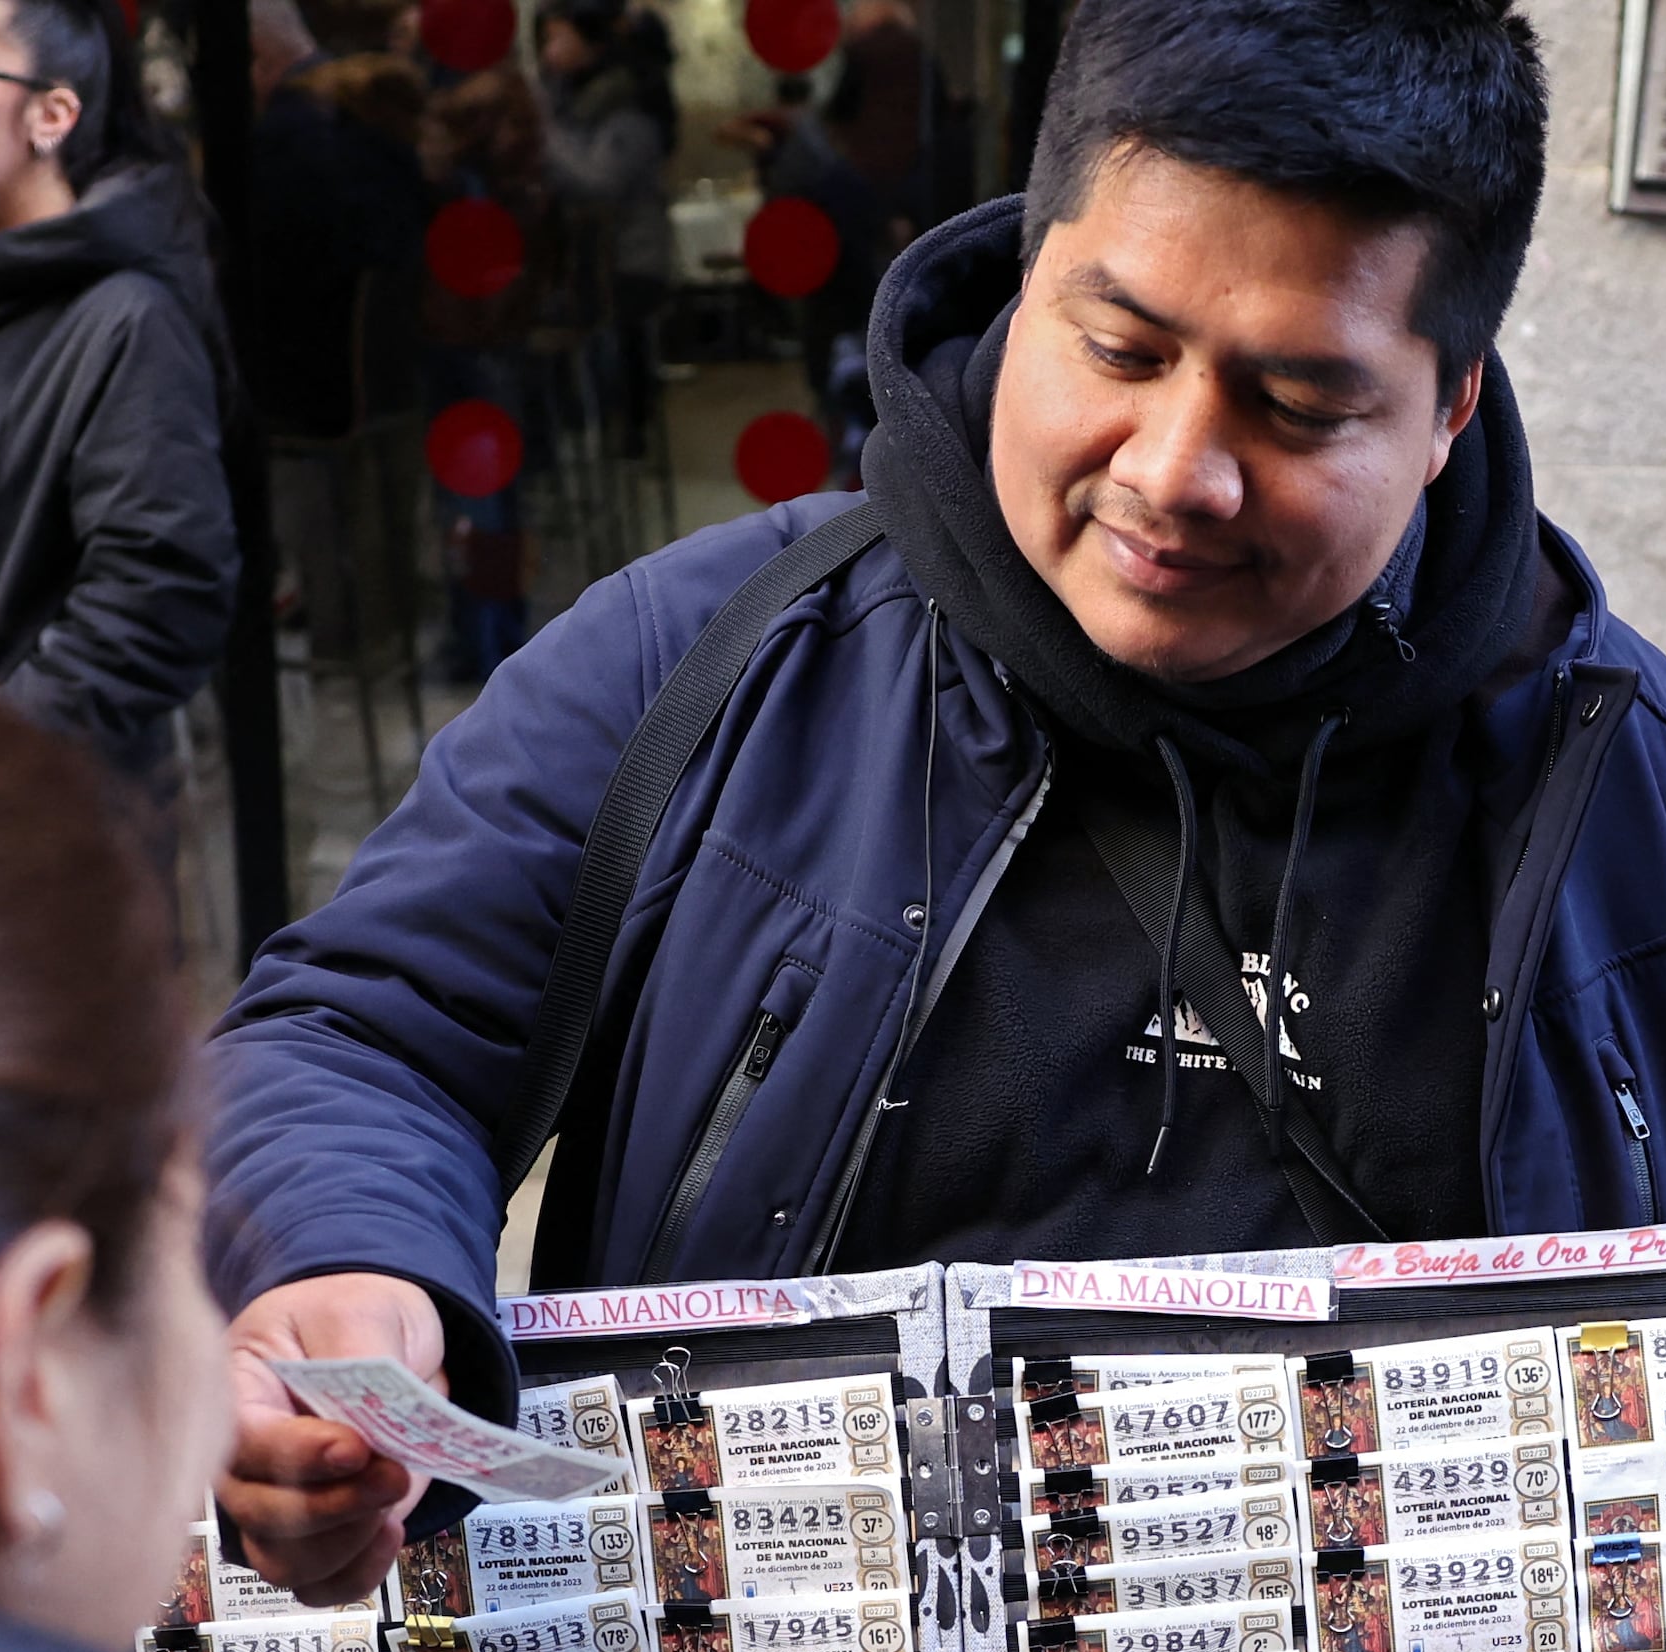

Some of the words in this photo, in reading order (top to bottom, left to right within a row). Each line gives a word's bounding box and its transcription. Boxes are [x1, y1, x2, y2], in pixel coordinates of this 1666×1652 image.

[1241, 952, 1311, 1013] BLNC
[1126, 1045, 1156, 1064] THE
[1175, 1052, 1227, 1071] HITE
[1336, 1245, 1384, 1280] La
[1393, 1243, 1480, 1283] Bruja
[1492, 1240, 1524, 1270] de
[1537, 1236, 1589, 1266] Oro
[1599, 1247, 1617, 1270] y
[1386, 1358, 1498, 1390] 83919
[726, 1404, 835, 1433] 28215
[1114, 1401, 1229, 1432] 47607
[1396, 1461, 1508, 1492] 42529
[735, 1506, 844, 1530] 83425
[1122, 1515, 1234, 1548] 95527
[477, 1522, 583, 1548] 78313
[477, 1556, 525, 1568] LOTERÍA
[529, 1555, 586, 1565] NACIONAL
[498, 1570, 512, 1578] DE
[516, 1567, 568, 1577] NAVIDAD
[1400, 1556, 1514, 1588] 23929
[1129, 1575, 1242, 1605] 31637
[1402, 1594, 1452, 1608] LOTERÍA
[1456, 1590, 1516, 1603] NACIONAL
[1423, 1609, 1438, 1618] DE
[1443, 1604, 1497, 1617] NAVIDAD
[745, 1617, 852, 1642] 17945
